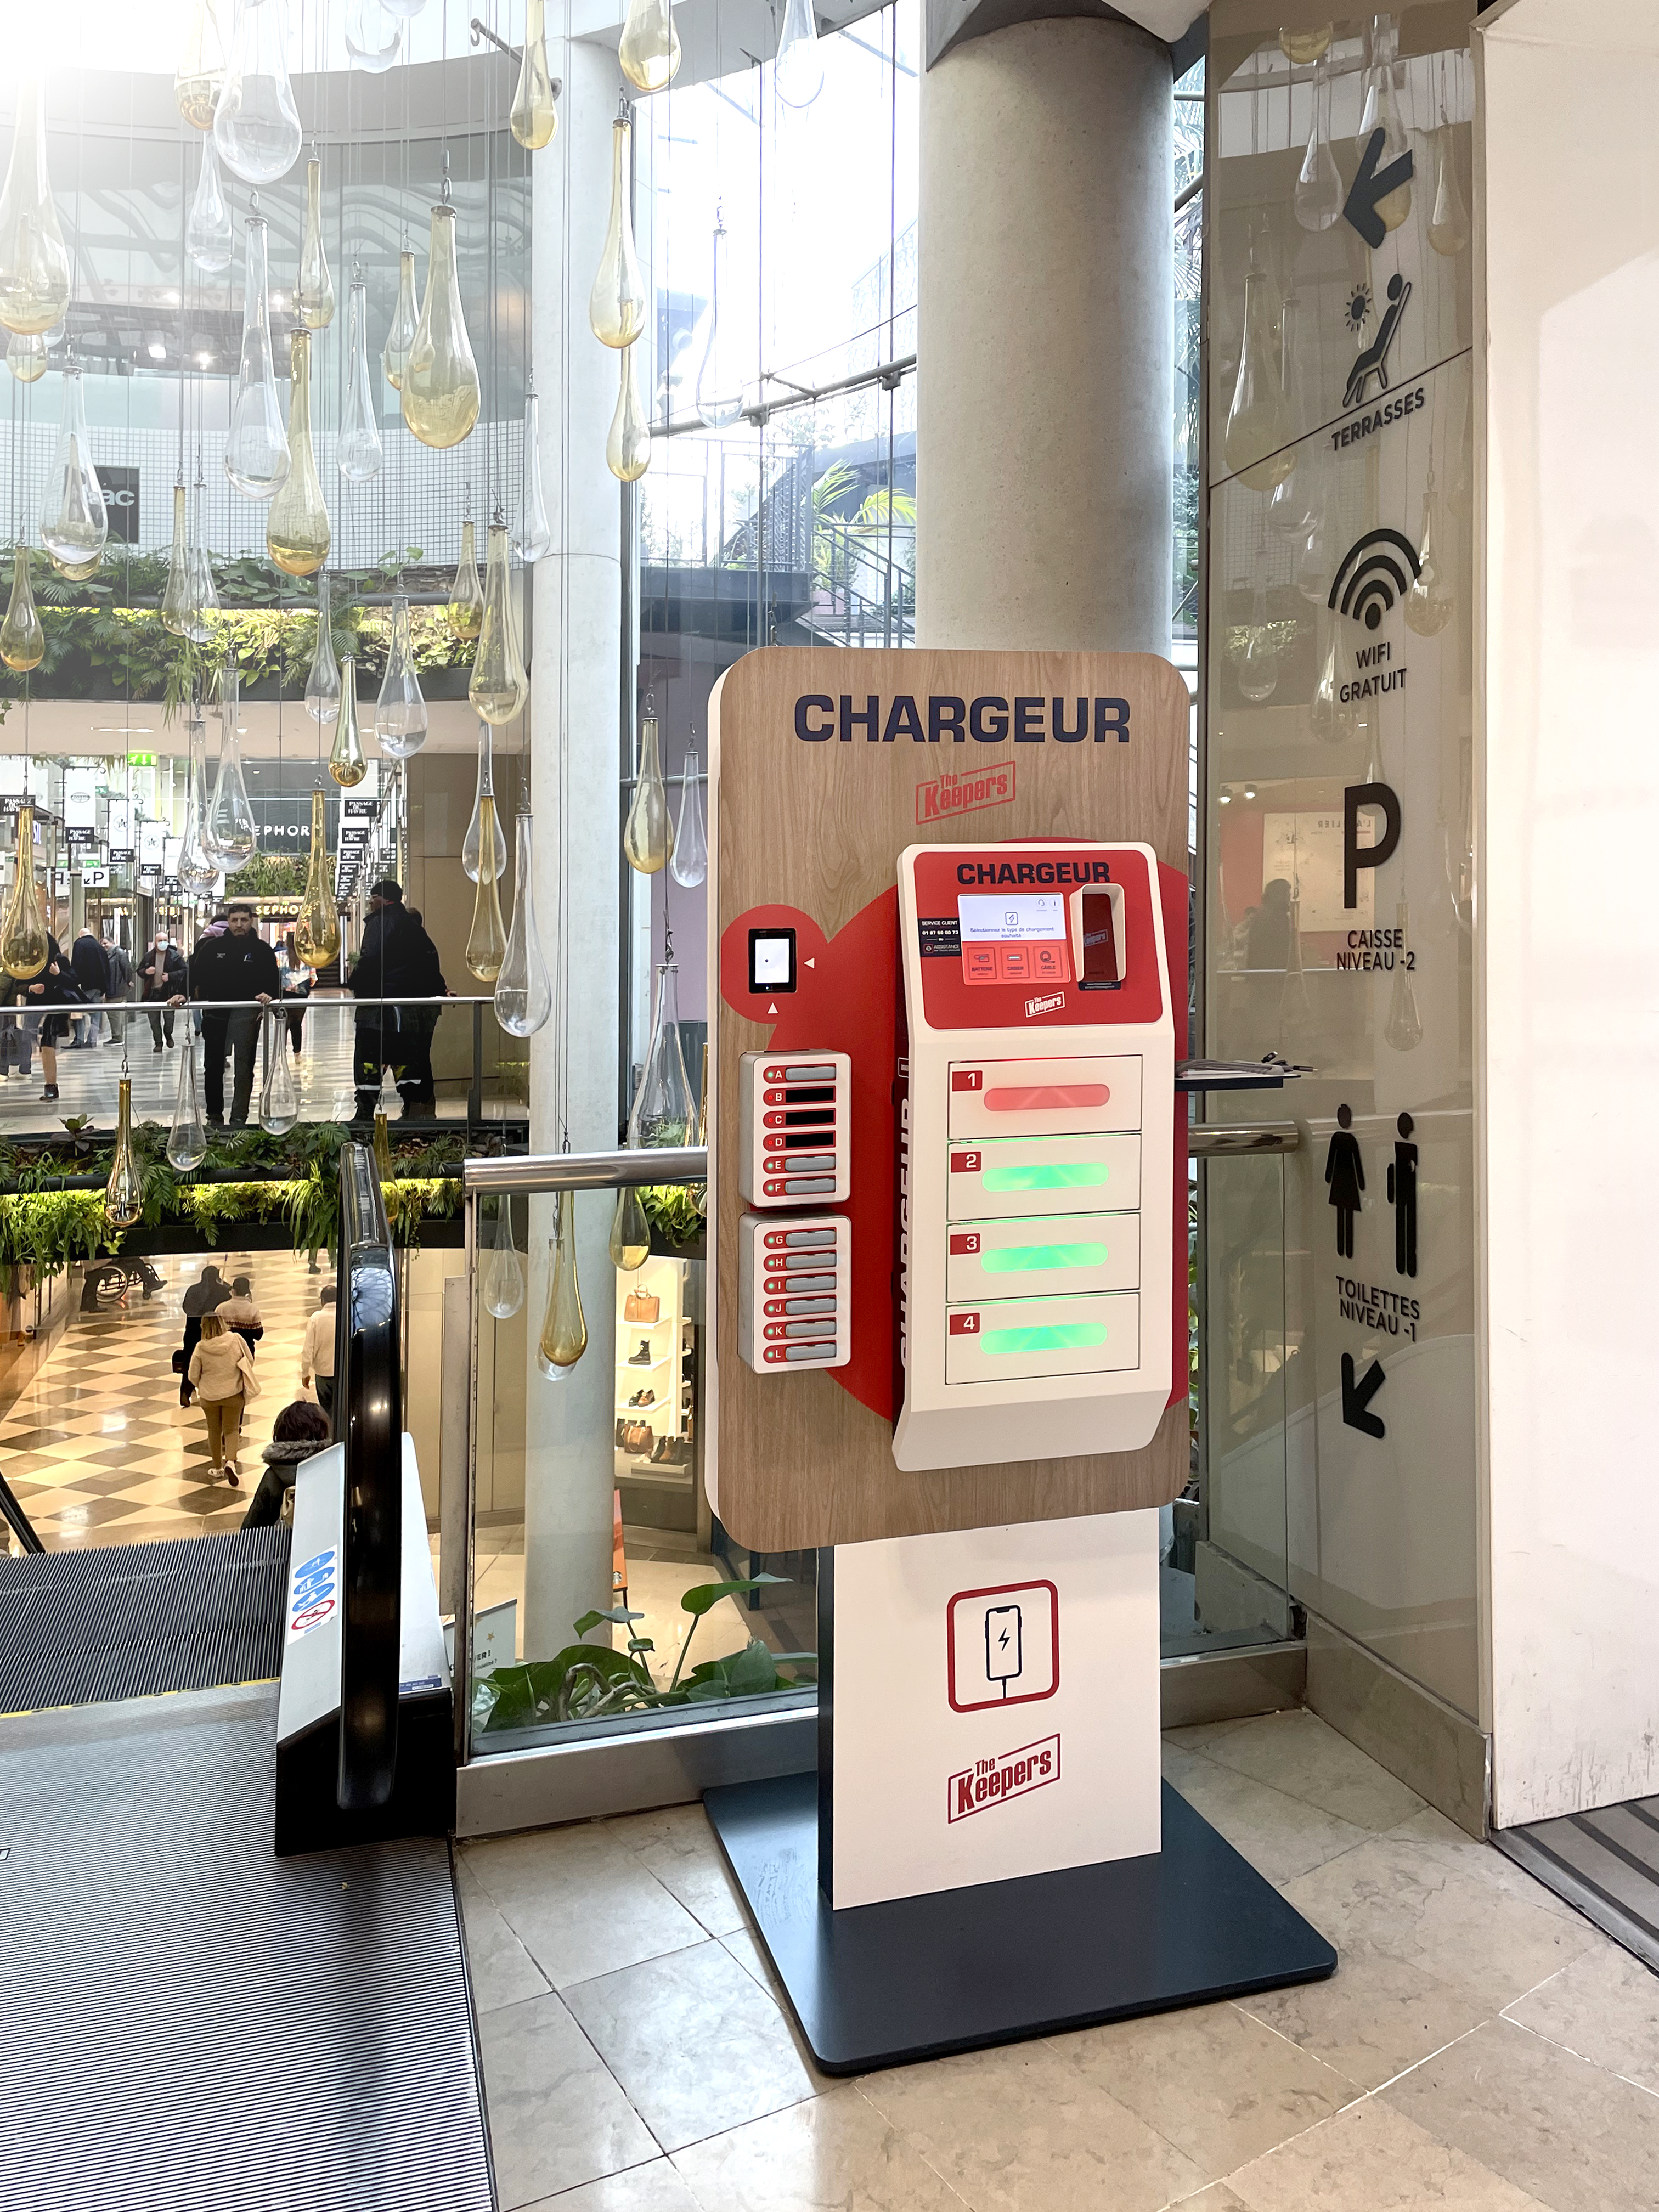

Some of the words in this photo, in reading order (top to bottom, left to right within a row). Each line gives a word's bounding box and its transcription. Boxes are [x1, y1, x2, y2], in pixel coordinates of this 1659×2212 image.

[1331, 387, 1425, 451] TERRASSES
[1356, 641, 1390, 669] WIFI
[1340, 668, 1407, 703] GRATUIT
[794, 694, 1130, 743] CHARGEUR
[940, 773, 958, 789] The
[924, 772, 1007, 818] Keepers
[255, 825, 310, 836] EPHOR
[1344, 782, 1401, 909] P
[93, 871, 104, 884] P
[957, 861, 1110, 884] CHARGEUR
[1347, 929, 1403, 949] CAISSE
[1336, 952, 1395, 970] NIVEAU
[1400, 951, 1415, 970] -2
[1028, 996, 1062, 1015] Keepers
[775, 1070, 782, 1079] A
[968, 1073, 976, 1087] 1
[775, 1093, 782, 1102] B
[775, 1115, 782, 1124] C
[775, 1138, 783, 1147] D
[775, 1161, 781, 1170] E
[966, 1154, 977, 1169] 2
[775, 1183, 781, 1192] F
[776, 1235, 783, 1244] G
[966, 1235, 977, 1250] 3
[776, 1258, 783, 1267] H
[1336, 1275, 1420, 1320] TOILETTES
[775, 1304, 782, 1312] J
[963, 1316, 975, 1330] 4
[1340, 1298, 1398, 1335] NIVEAU
[1404, 1322, 1415, 1342] -1
[775, 1327, 783, 1335] K
[775, 1349, 781, 1358] L
[975, 1758, 995, 1776] The
[958, 1750, 1052, 1814] Keepers
